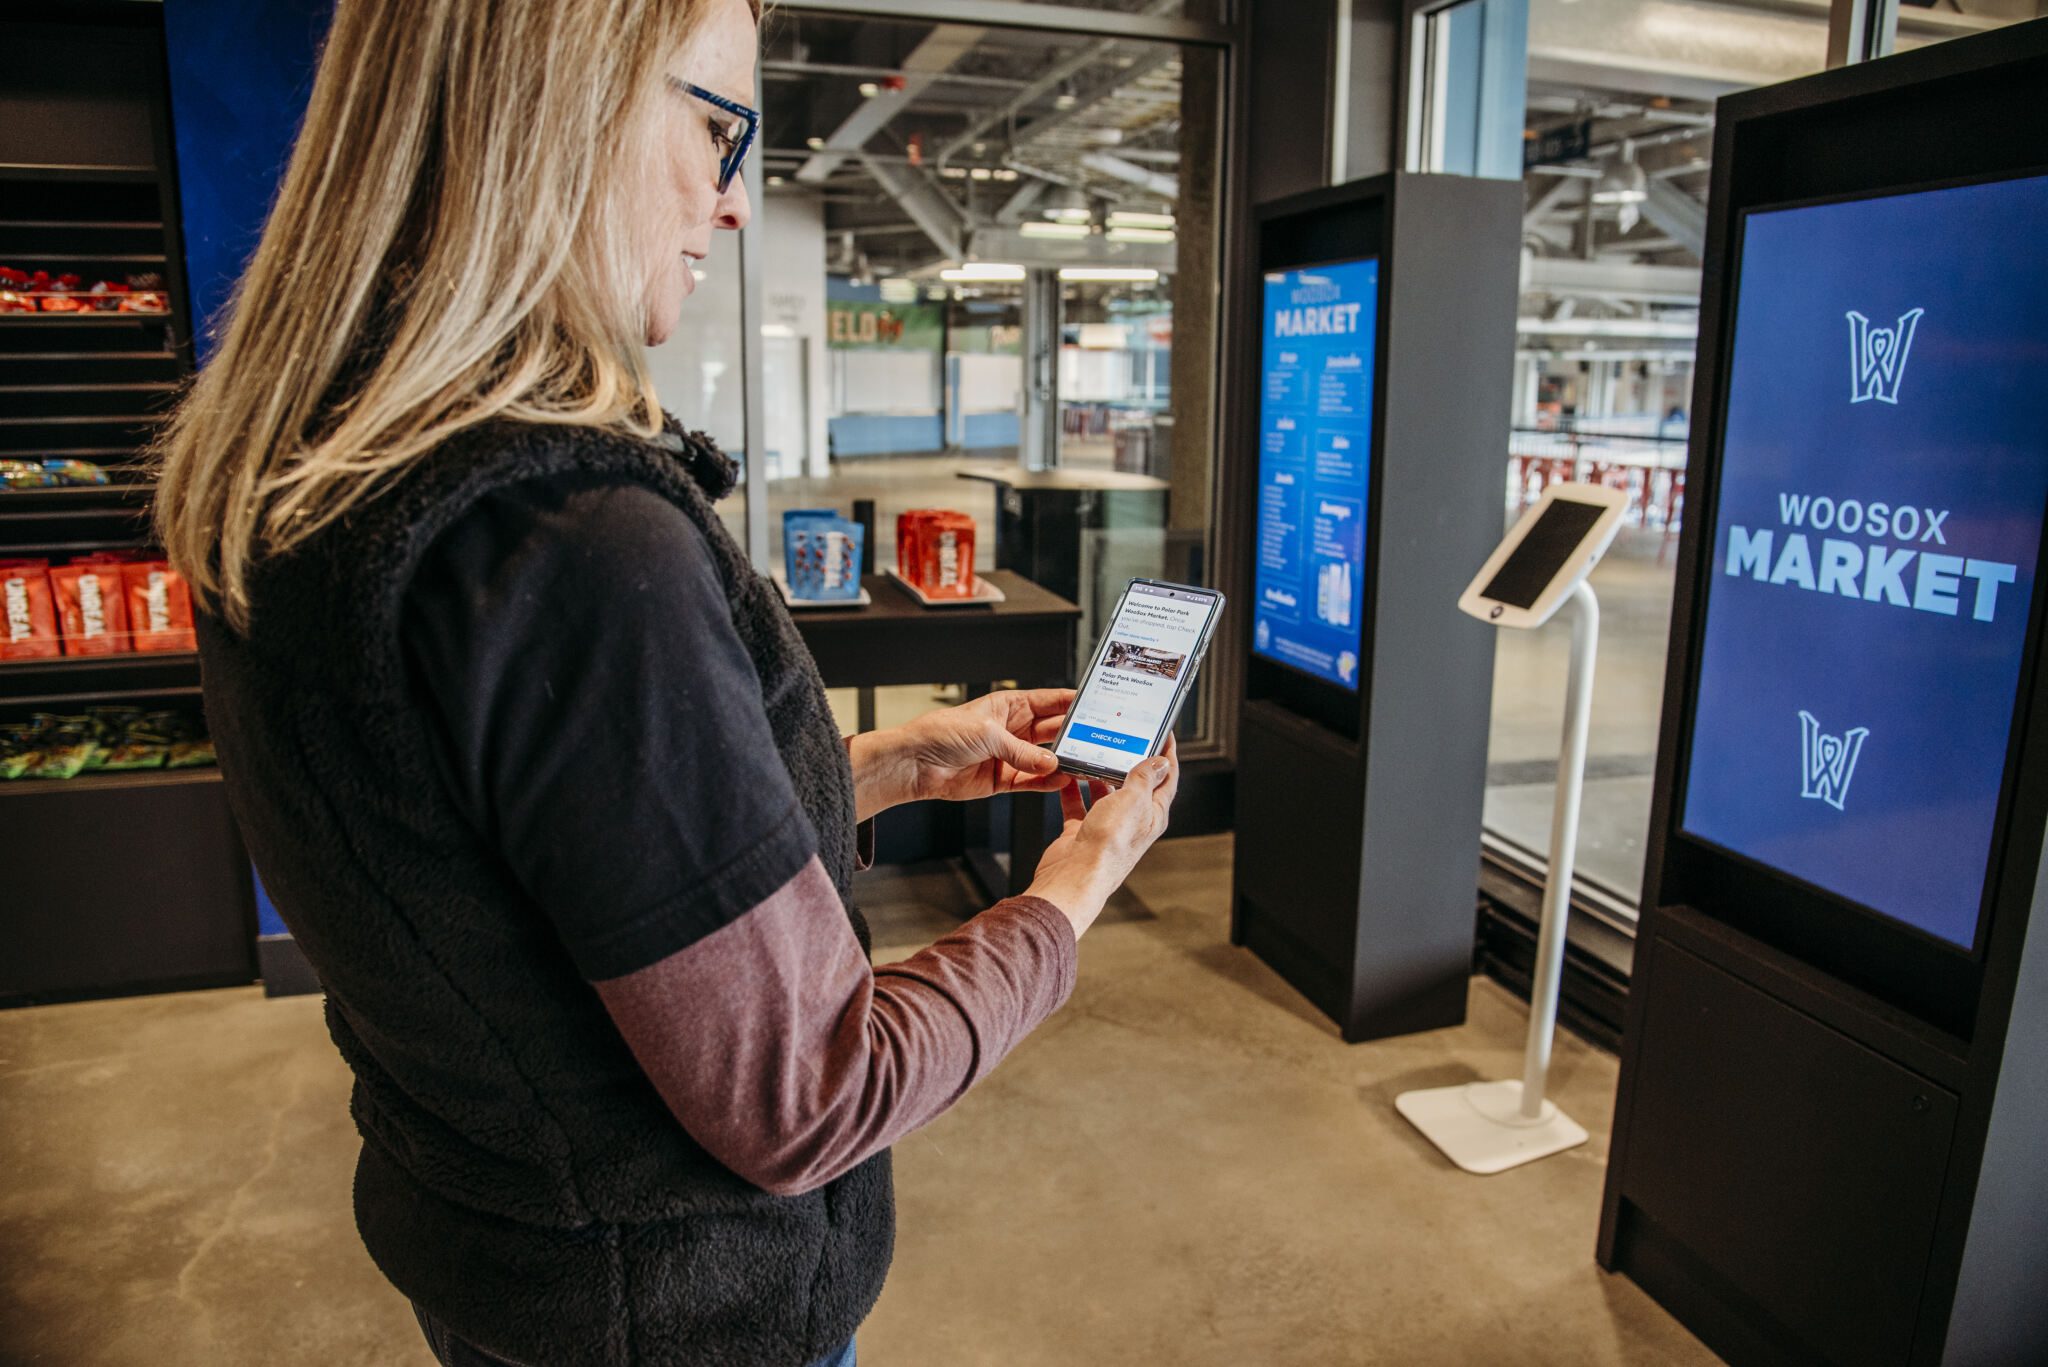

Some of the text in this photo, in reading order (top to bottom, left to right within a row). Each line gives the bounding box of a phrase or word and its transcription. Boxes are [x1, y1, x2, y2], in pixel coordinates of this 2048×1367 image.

[1275, 303, 1360, 337] MARKET
[1779, 493, 1949, 545] WOOSOX
[1725, 525, 2017, 622] MARKET
[1128, 601, 1153, 610] Welcome
[1125, 608, 1146, 617] WooSox
[1099, 678, 1119, 687] Market
[1116, 674, 1130, 682] Park
[1131, 677, 1153, 687] WooSox
[1090, 732, 1127, 745] CHECK OUT
